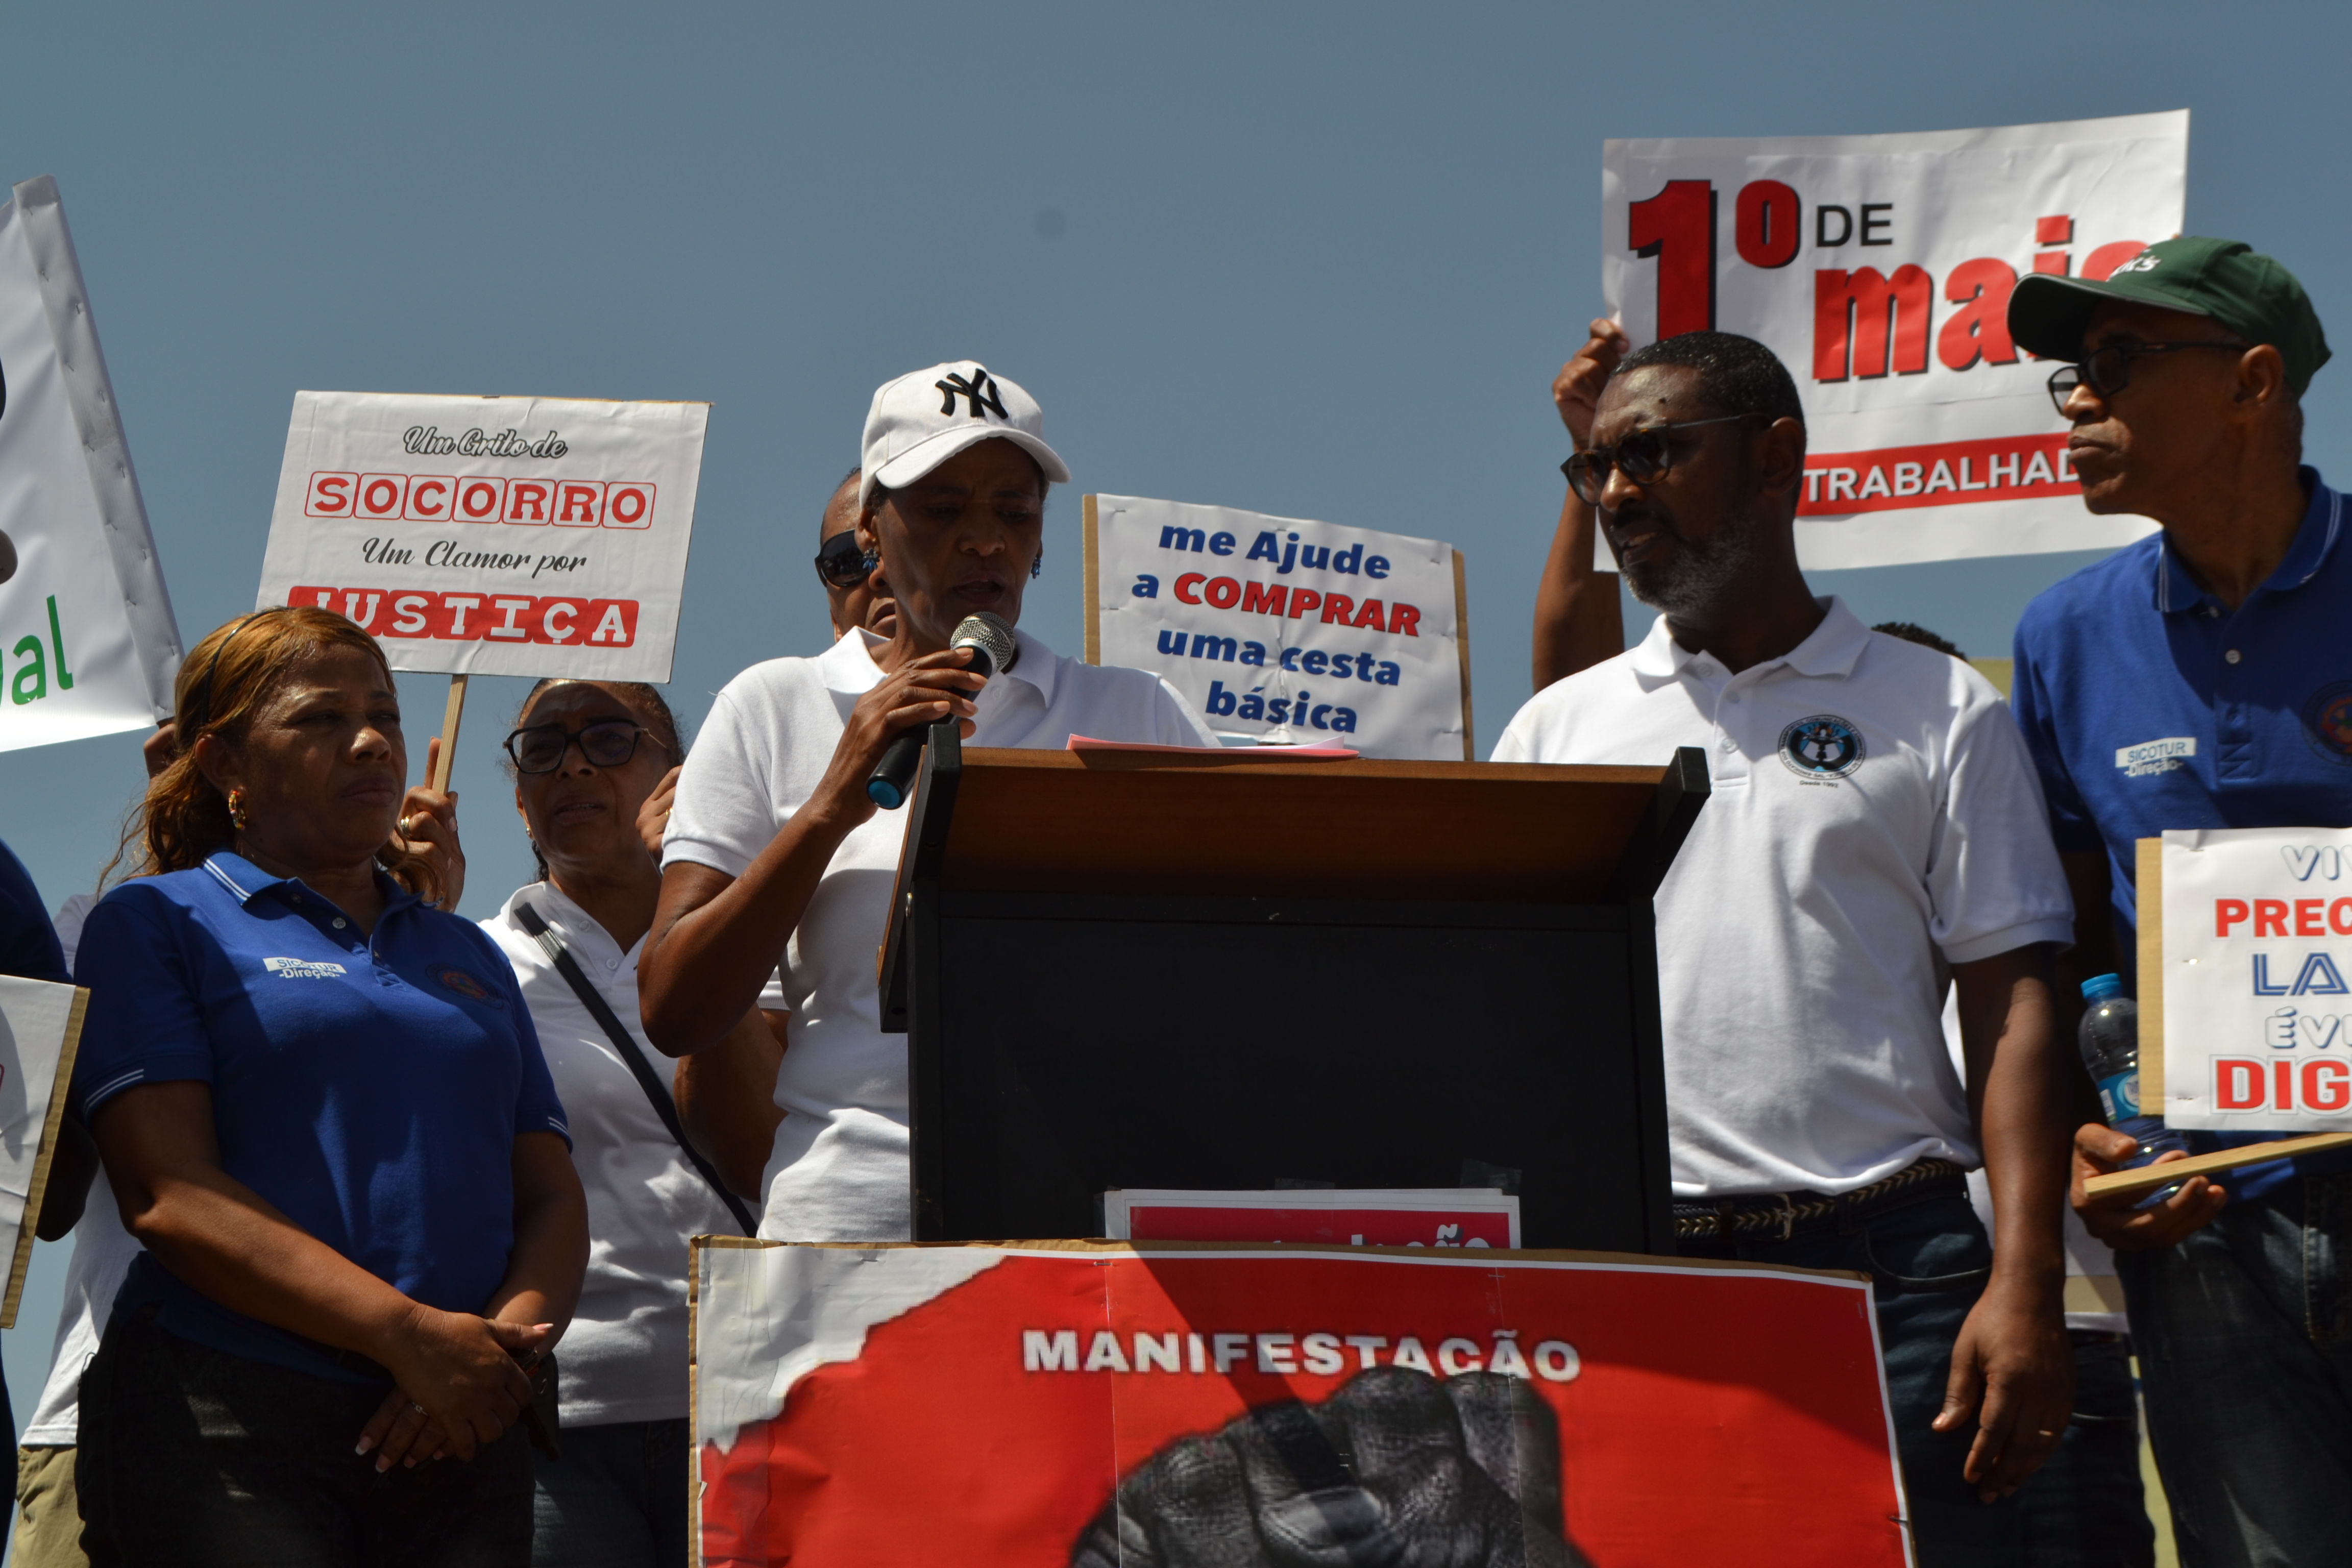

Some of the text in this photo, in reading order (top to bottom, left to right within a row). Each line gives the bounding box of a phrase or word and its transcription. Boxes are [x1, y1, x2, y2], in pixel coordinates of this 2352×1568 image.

[1816, 203, 1893, 248] DE
[403, 426, 568, 459] Um Grito de
[314, 477, 646, 524] SOCORRO
[1802, 447, 2079, 502] TRABALHAD
[362, 537, 587, 579] Um Clamor por
[1159, 525, 1391, 579] me Ajude
[1132, 572, 1421, 637] a COMPRAR
[0, 594, 74, 708] al
[1157, 629, 1401, 686] uma cesta
[1205, 680, 1357, 733] básica
[2127, 742, 2186, 764] SICOTUR
[277, 959, 337, 971] SICOTUR
[2215, 1058, 2351, 1111] DIG
